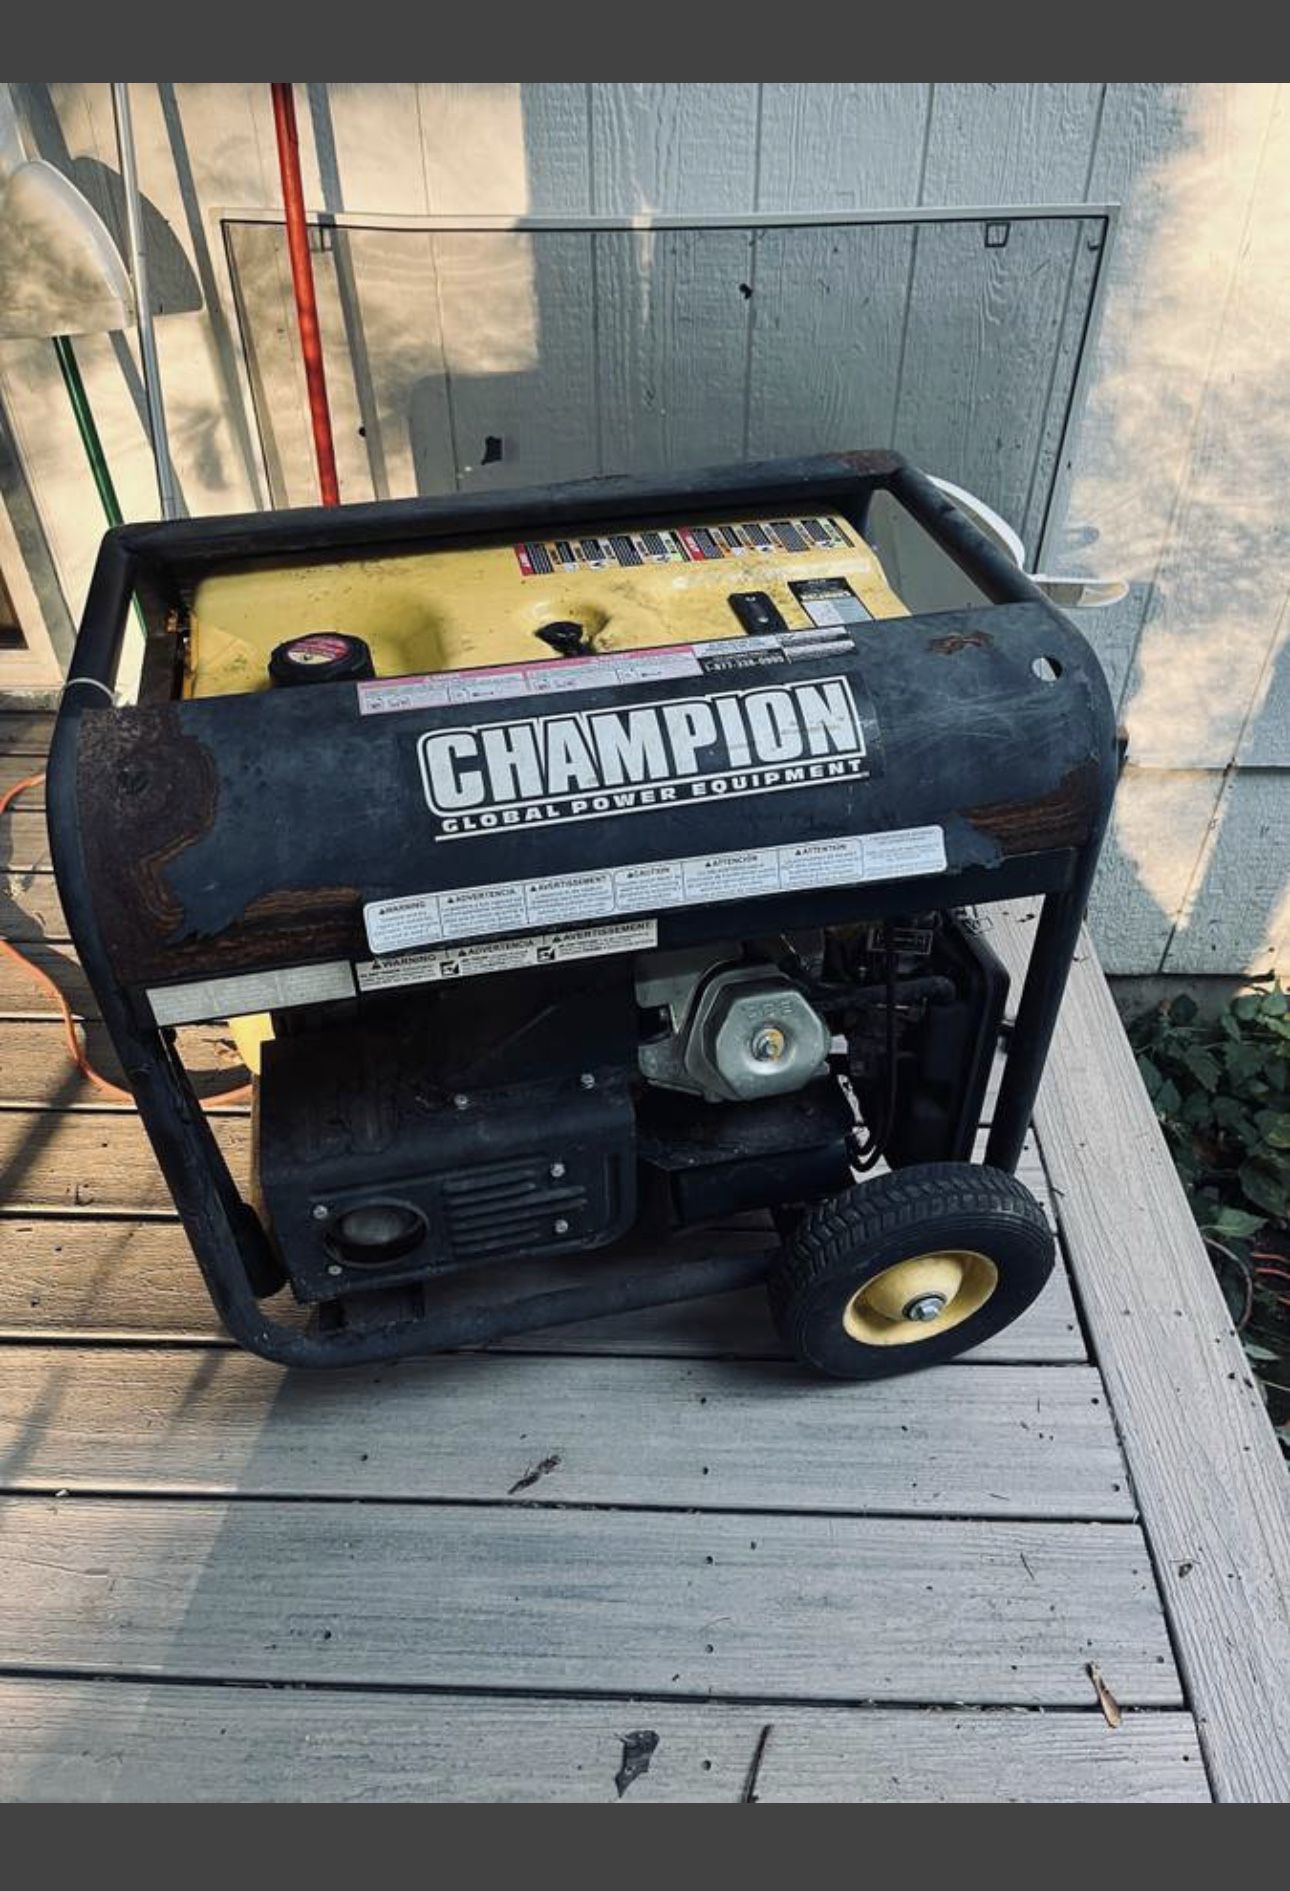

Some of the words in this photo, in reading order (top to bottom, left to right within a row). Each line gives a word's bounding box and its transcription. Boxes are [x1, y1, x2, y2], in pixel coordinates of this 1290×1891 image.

[424, 680, 859, 810] CHAMPION
[441, 804, 561, 833] GLOBAL
[571, 787, 678, 814] POWER
[692, 759, 862, 797] EQUIPMENT
[563, 921, 650, 941] AVERTISSEMENT
[467, 939, 535, 955] ADVERTENCIA
[382, 953, 437, 969] WARNING
